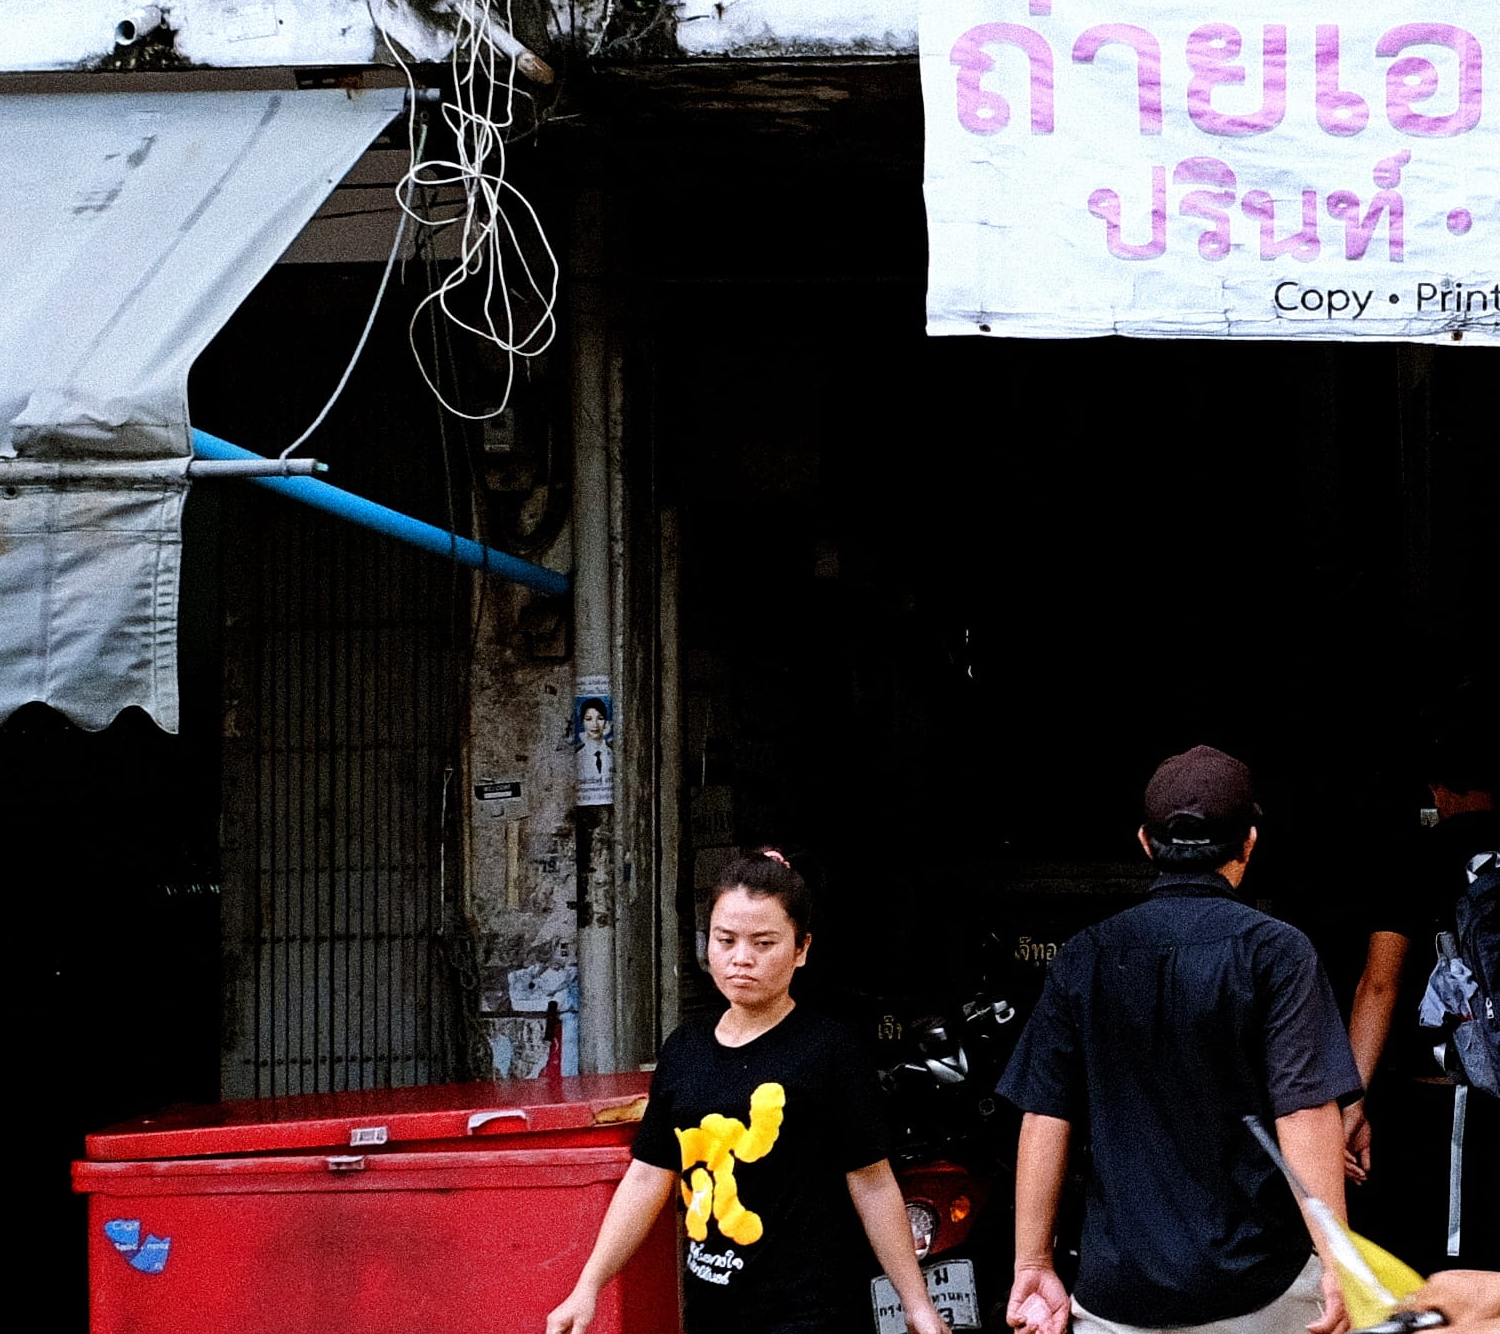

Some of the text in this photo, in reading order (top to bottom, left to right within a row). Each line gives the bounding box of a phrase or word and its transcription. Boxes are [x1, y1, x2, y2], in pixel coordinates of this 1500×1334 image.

[1087, 149, 1412, 263] ปรินท์
[1274, 280, 1374, 319] Copy
